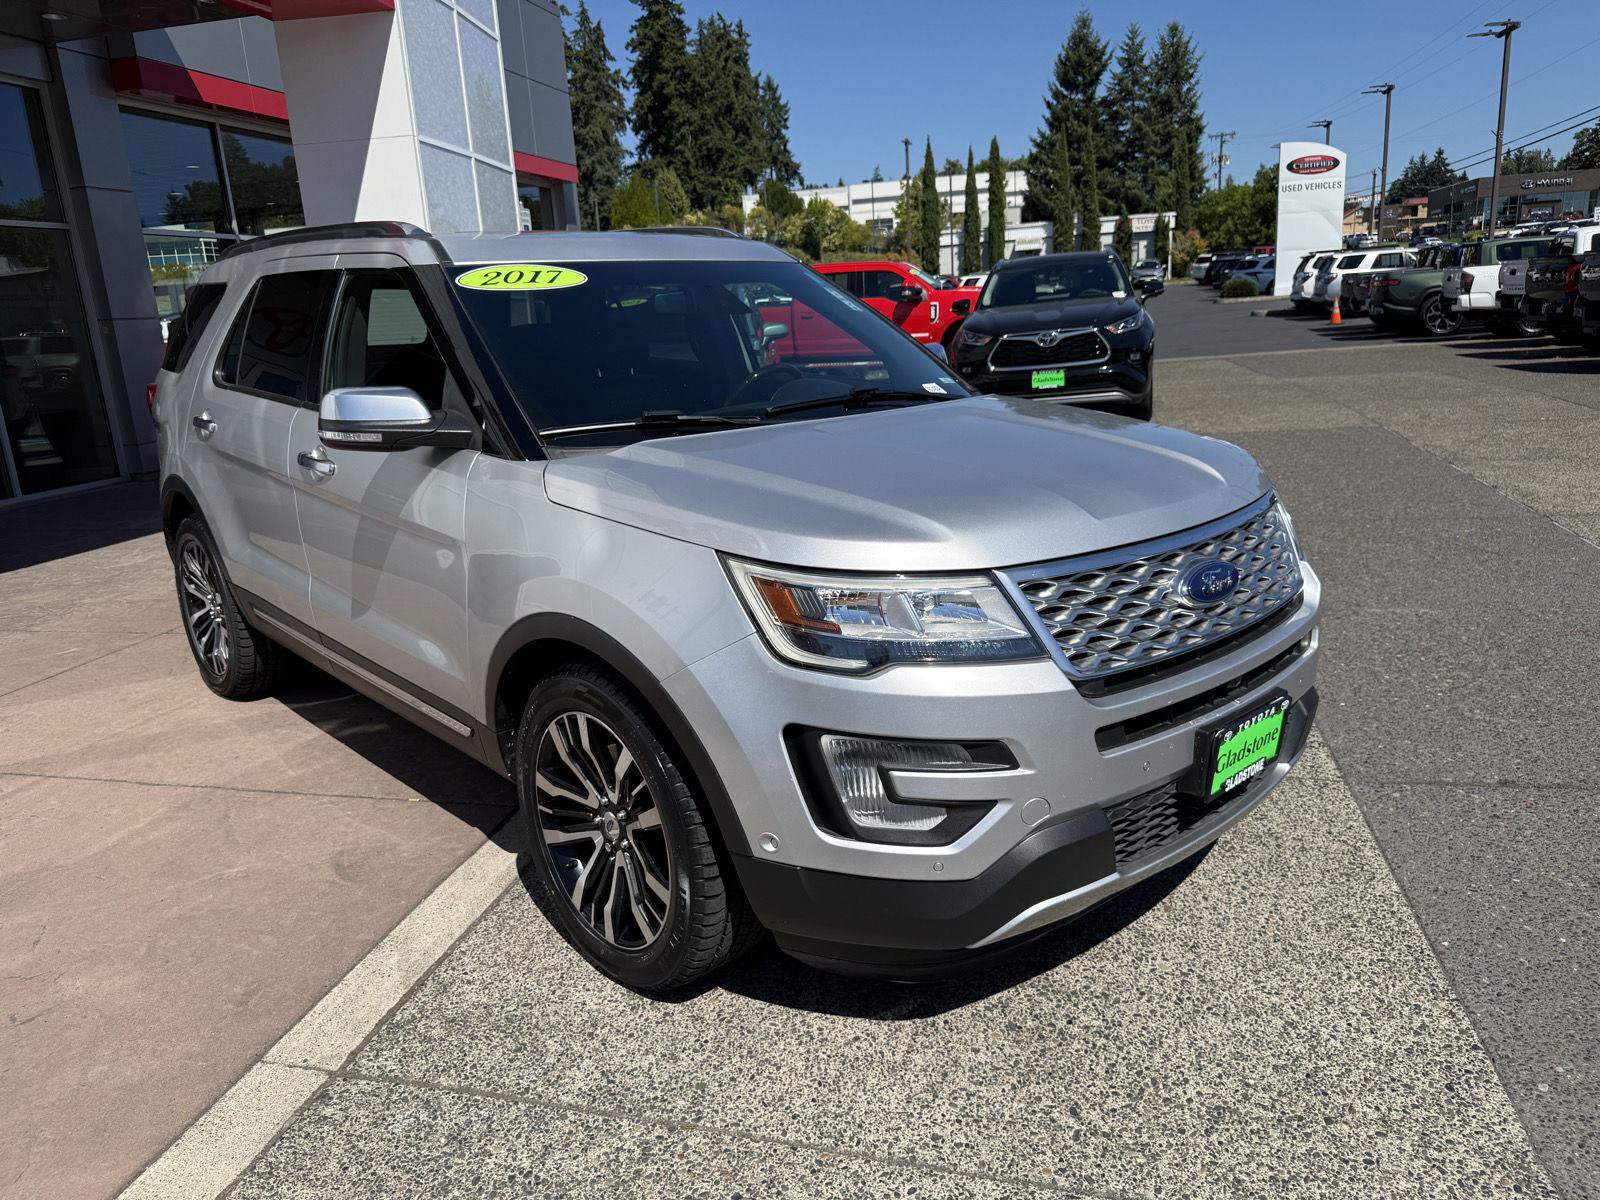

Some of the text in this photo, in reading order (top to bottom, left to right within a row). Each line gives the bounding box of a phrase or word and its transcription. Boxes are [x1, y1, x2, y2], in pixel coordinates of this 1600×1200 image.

[1293, 160, 1334, 170] CERTIFIED
[1281, 181, 1342, 193] USED VEHICLES
[480, 270, 563, 287] 2017
[1200, 567, 1231, 590] Ford
[1238, 706, 1276, 732] TOYOTA
[1215, 727, 1279, 774] Gladstone
[1224, 758, 1266, 792] GLADSTONE
